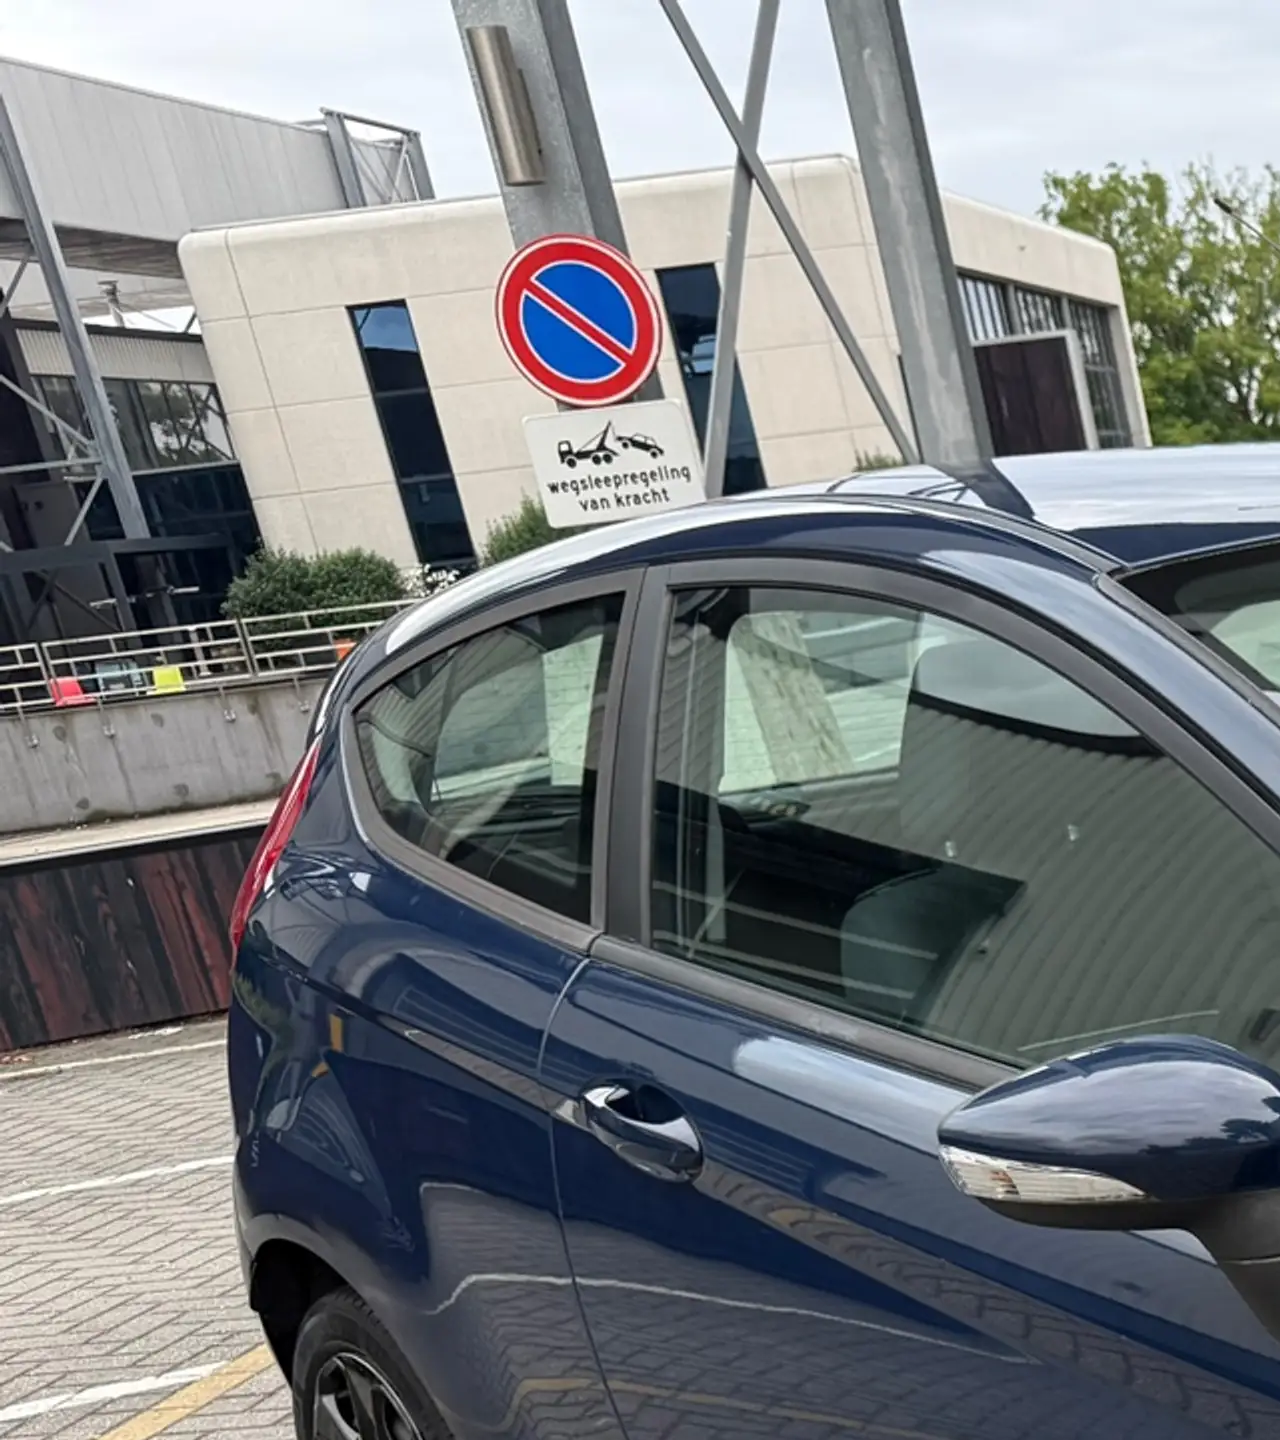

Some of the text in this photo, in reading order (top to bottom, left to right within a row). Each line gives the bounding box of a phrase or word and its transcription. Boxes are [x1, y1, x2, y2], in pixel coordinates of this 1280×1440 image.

[547, 465, 691, 496] wegsleepregeling
[578, 487, 670, 512] van kracht
